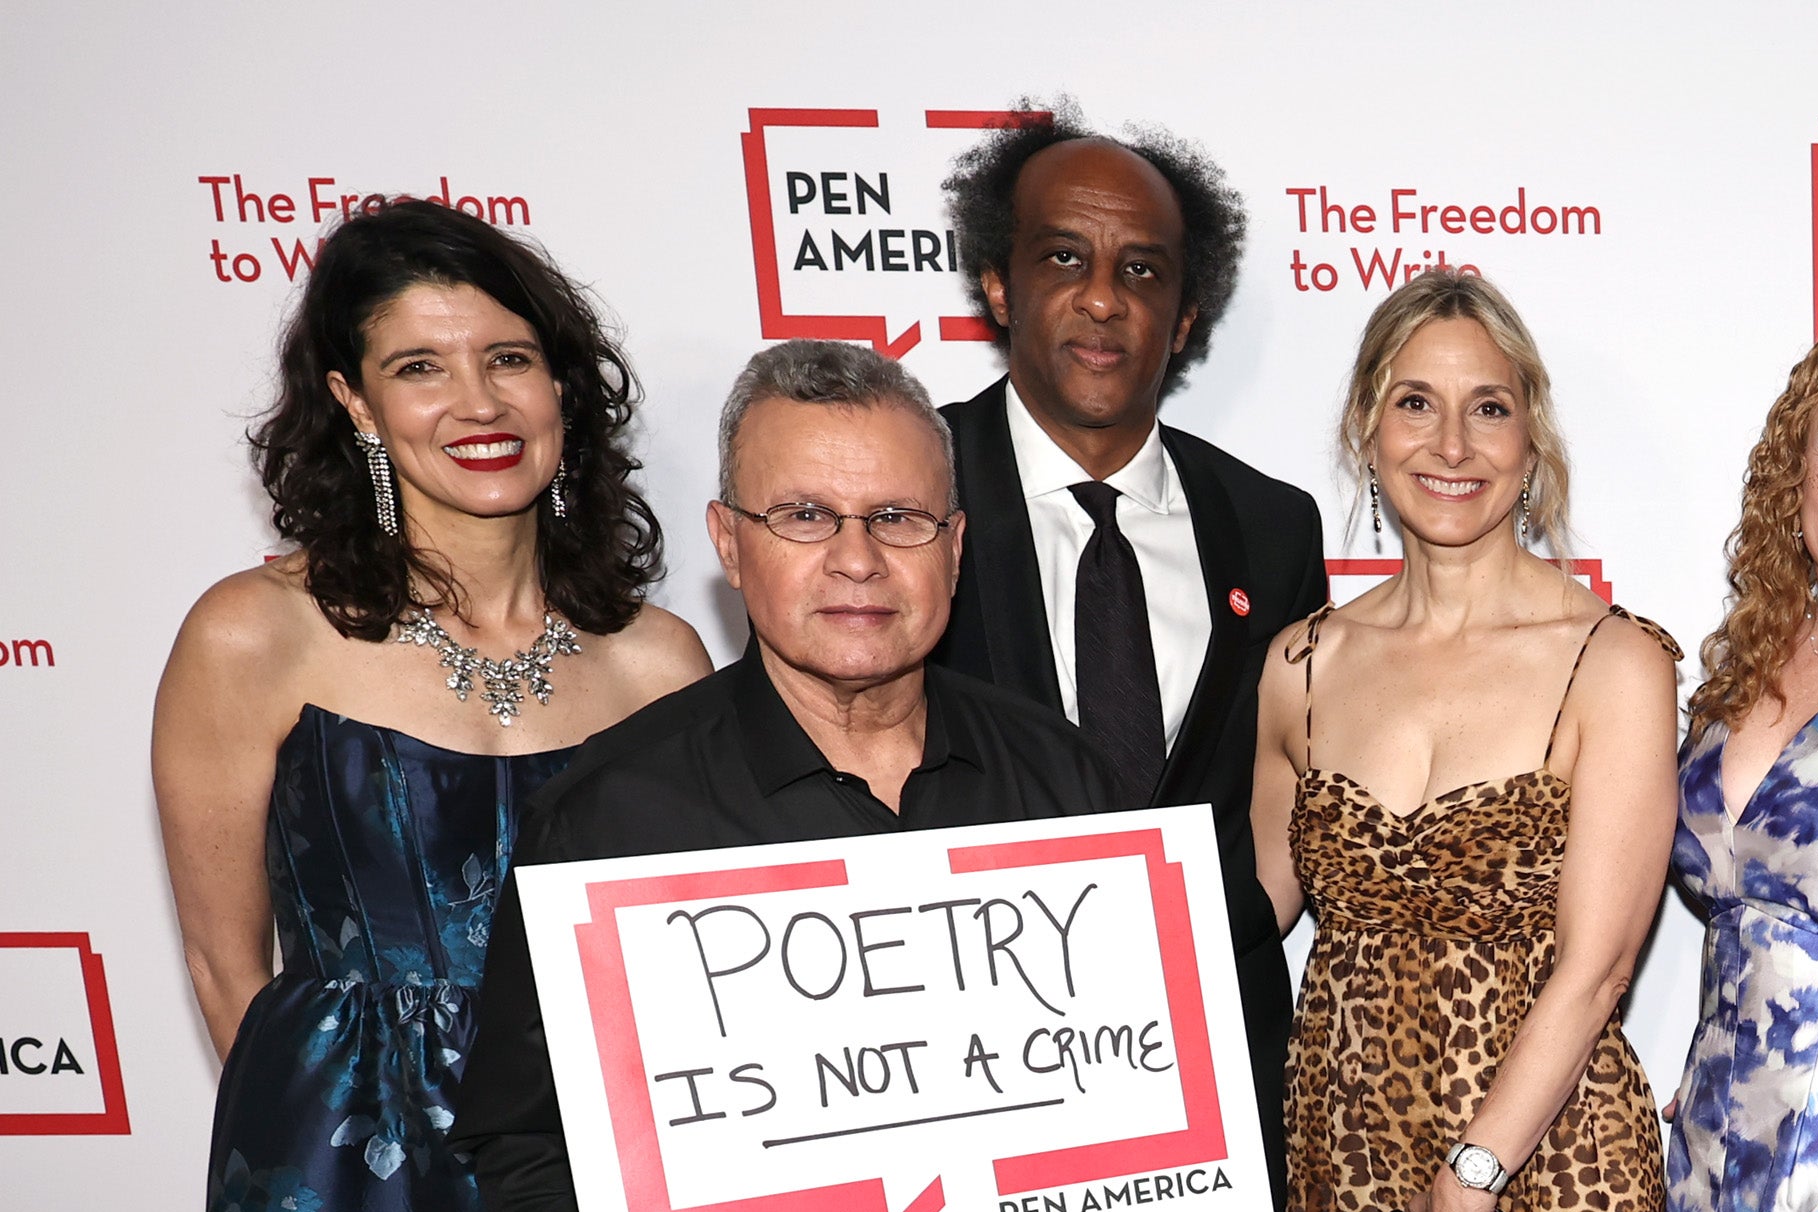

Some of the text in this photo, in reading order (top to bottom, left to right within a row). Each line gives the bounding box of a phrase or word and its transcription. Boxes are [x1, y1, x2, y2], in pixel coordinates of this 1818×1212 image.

[198, 173, 296, 224] The
[786, 171, 891, 215] PEN
[1285, 185, 1601, 235] The Freedom
[209, 239, 262, 283] to
[793, 228, 958, 273] AMERI
[1290, 249, 1339, 292] to
[666, 883, 1098, 1037] POETRY
[654, 1020, 1175, 1127] IS NOT A CRIME
